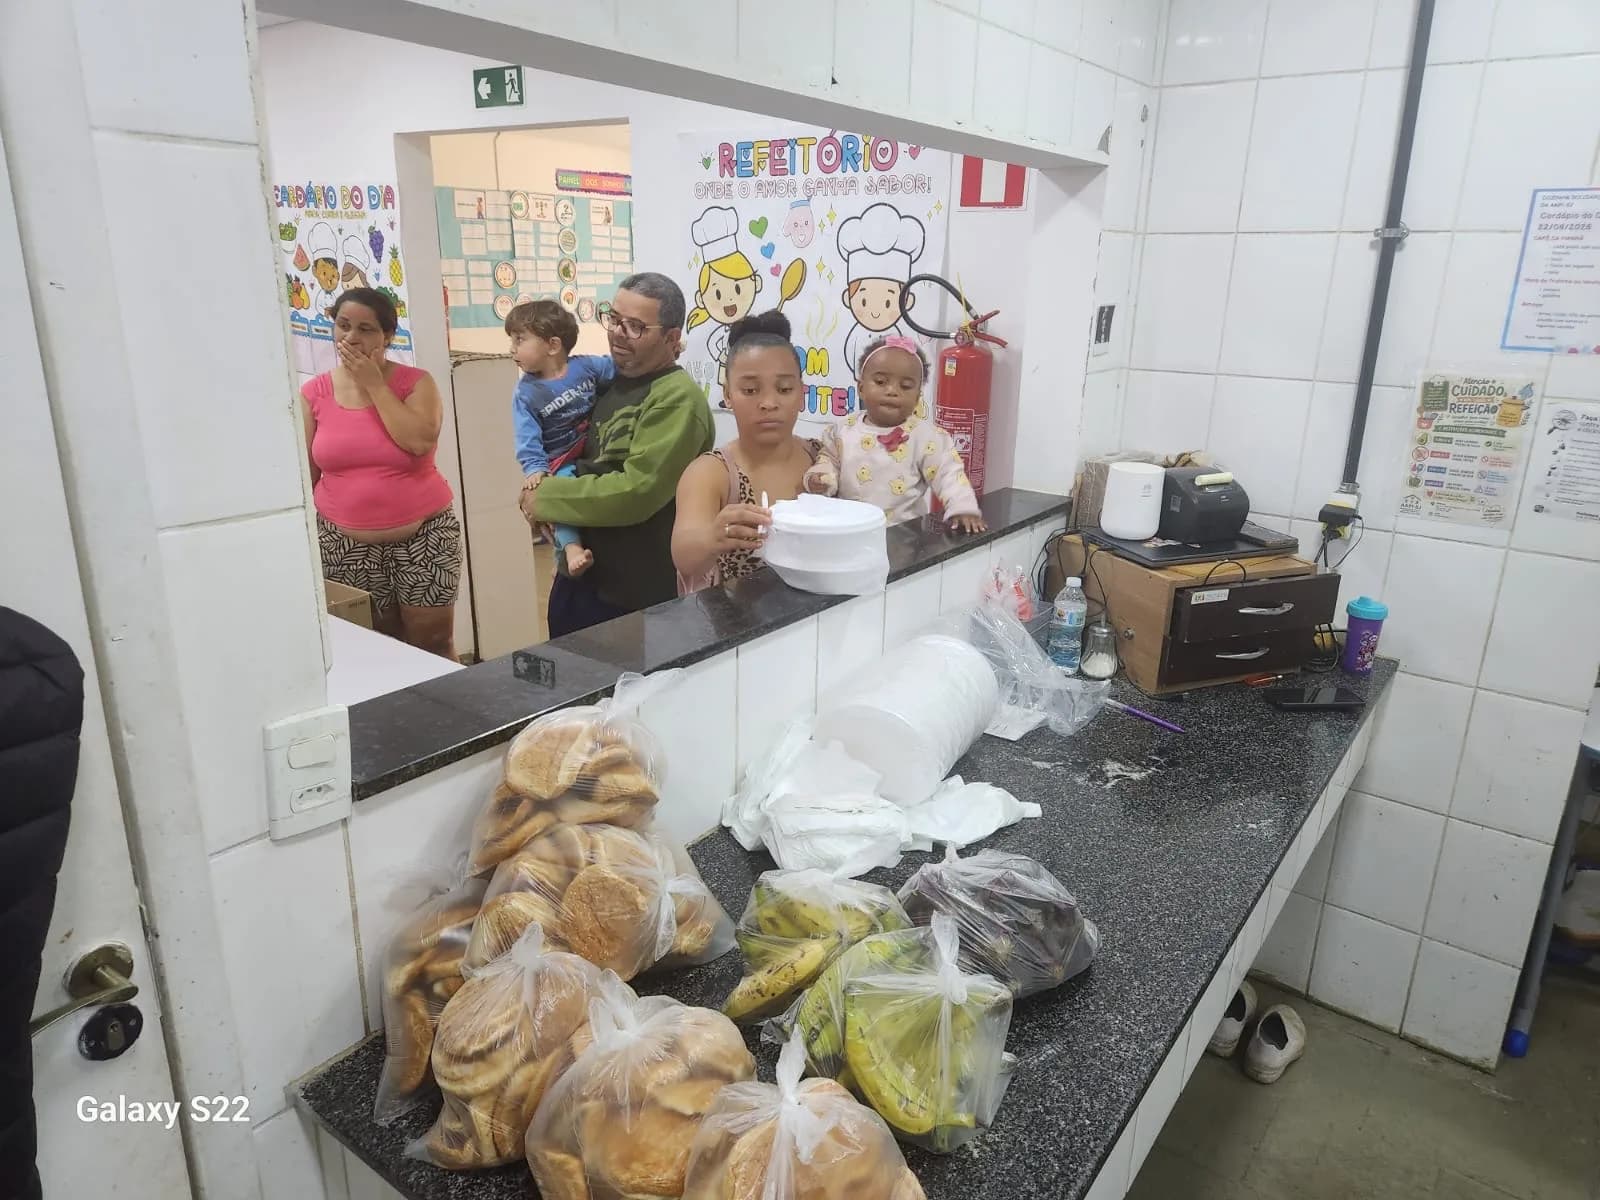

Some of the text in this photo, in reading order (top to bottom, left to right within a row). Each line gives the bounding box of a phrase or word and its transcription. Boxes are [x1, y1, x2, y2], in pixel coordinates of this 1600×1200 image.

[340, 185, 364, 210] DO
[367, 184, 395, 210] DIA
[694, 173, 932, 200] ONDE O AMOR GANHA SABOR!
